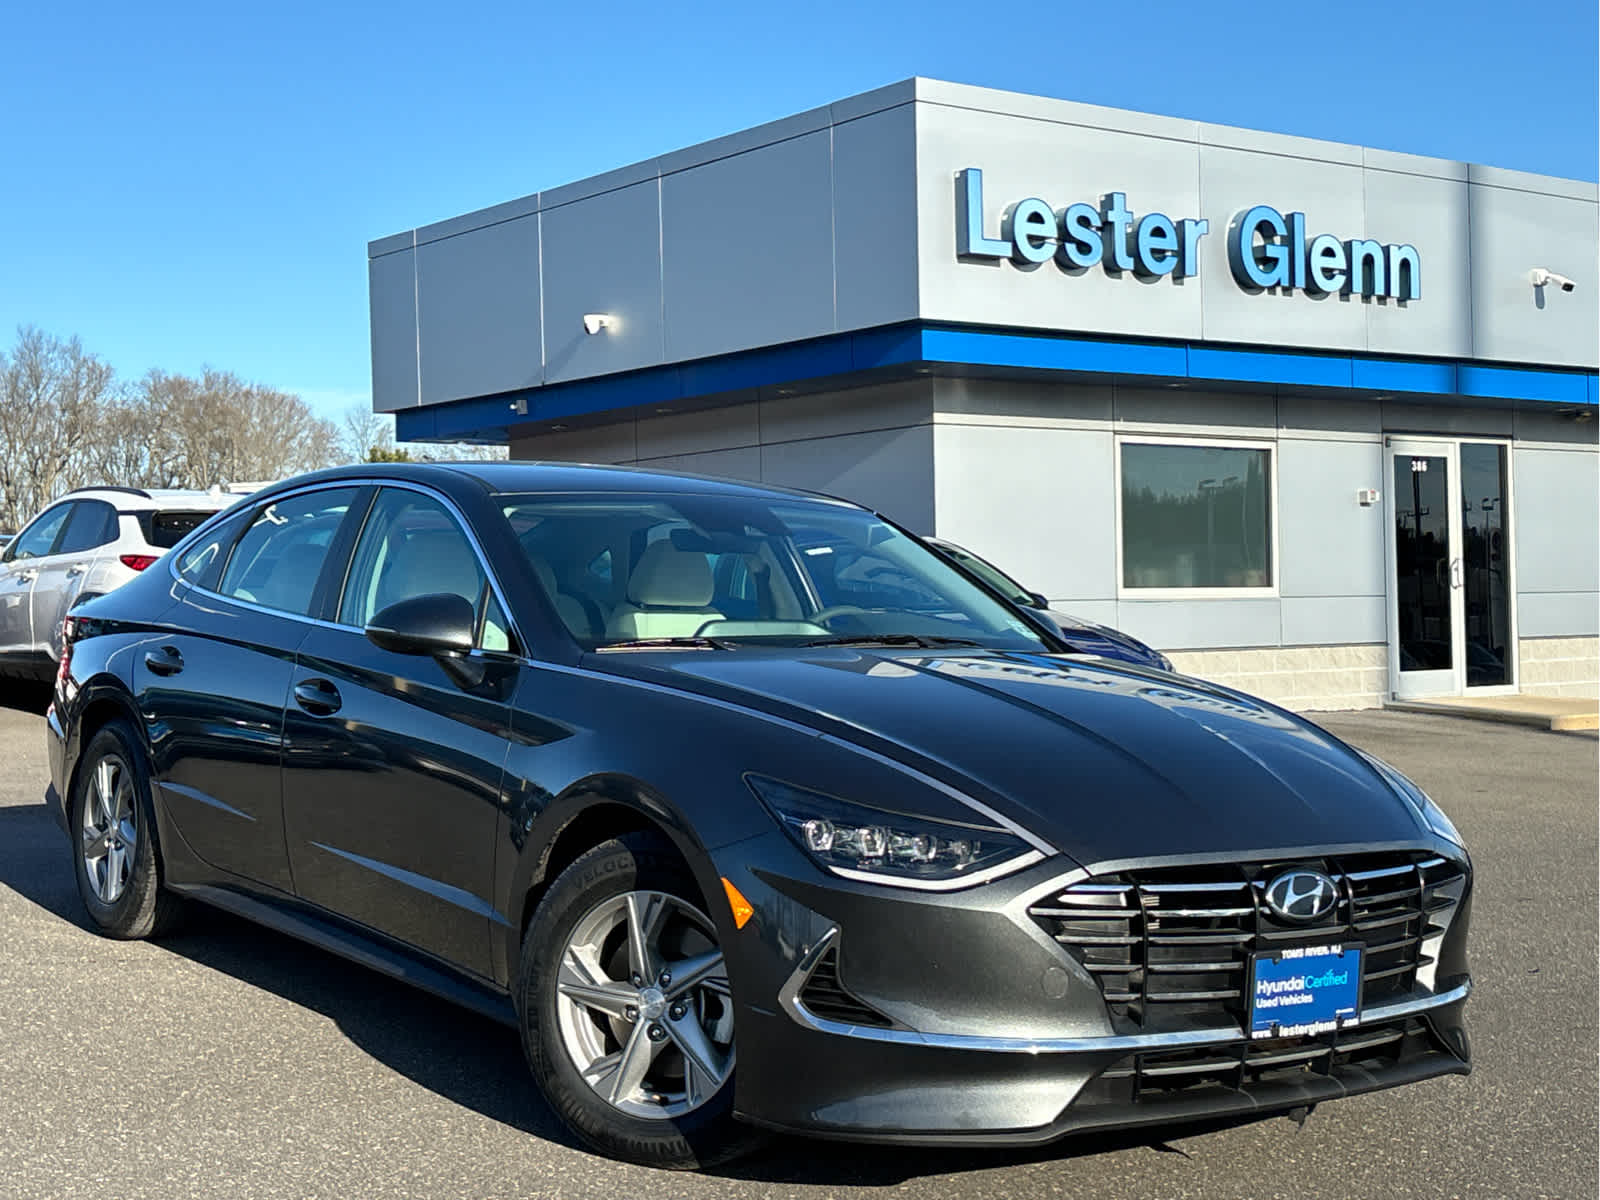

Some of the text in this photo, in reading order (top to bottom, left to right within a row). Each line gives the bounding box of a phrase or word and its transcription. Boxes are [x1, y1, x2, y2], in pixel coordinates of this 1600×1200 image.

[954, 167, 1421, 305] Lester Glenn
[1256, 993, 1313, 1009] Used Vehicles
